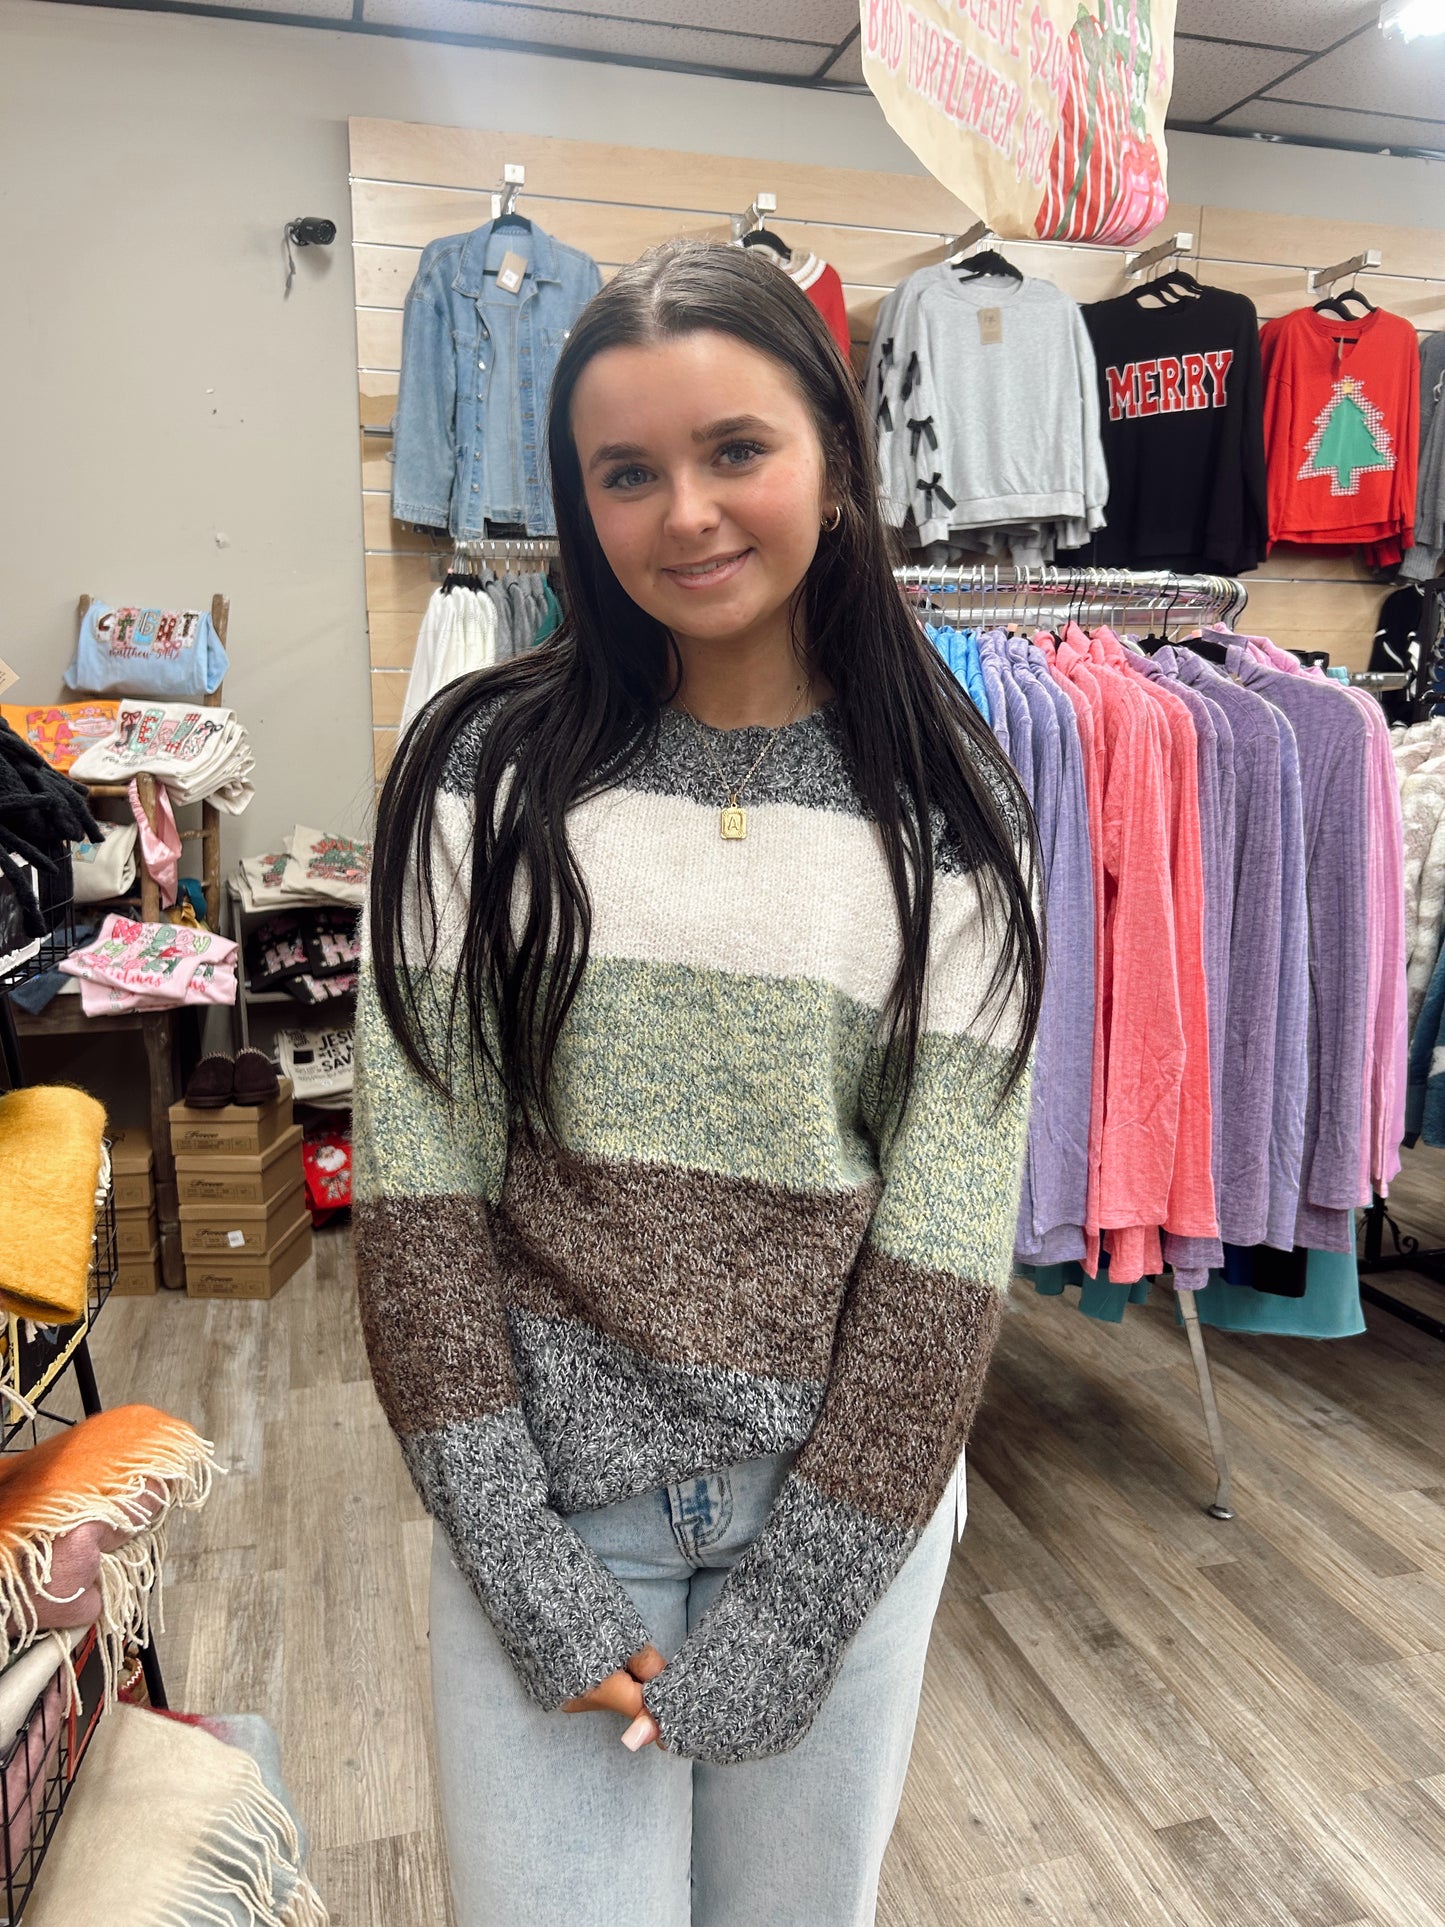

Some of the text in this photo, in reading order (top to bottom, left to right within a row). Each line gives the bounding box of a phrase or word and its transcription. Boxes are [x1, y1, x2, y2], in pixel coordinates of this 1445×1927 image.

[1029, 5, 1064, 91] $20
[907, 12, 1021, 155] TURTLENECK
[1016, 108, 1048, 186] $18
[1106, 349, 1233, 421] MERRY
[727, 815, 739, 831] A
